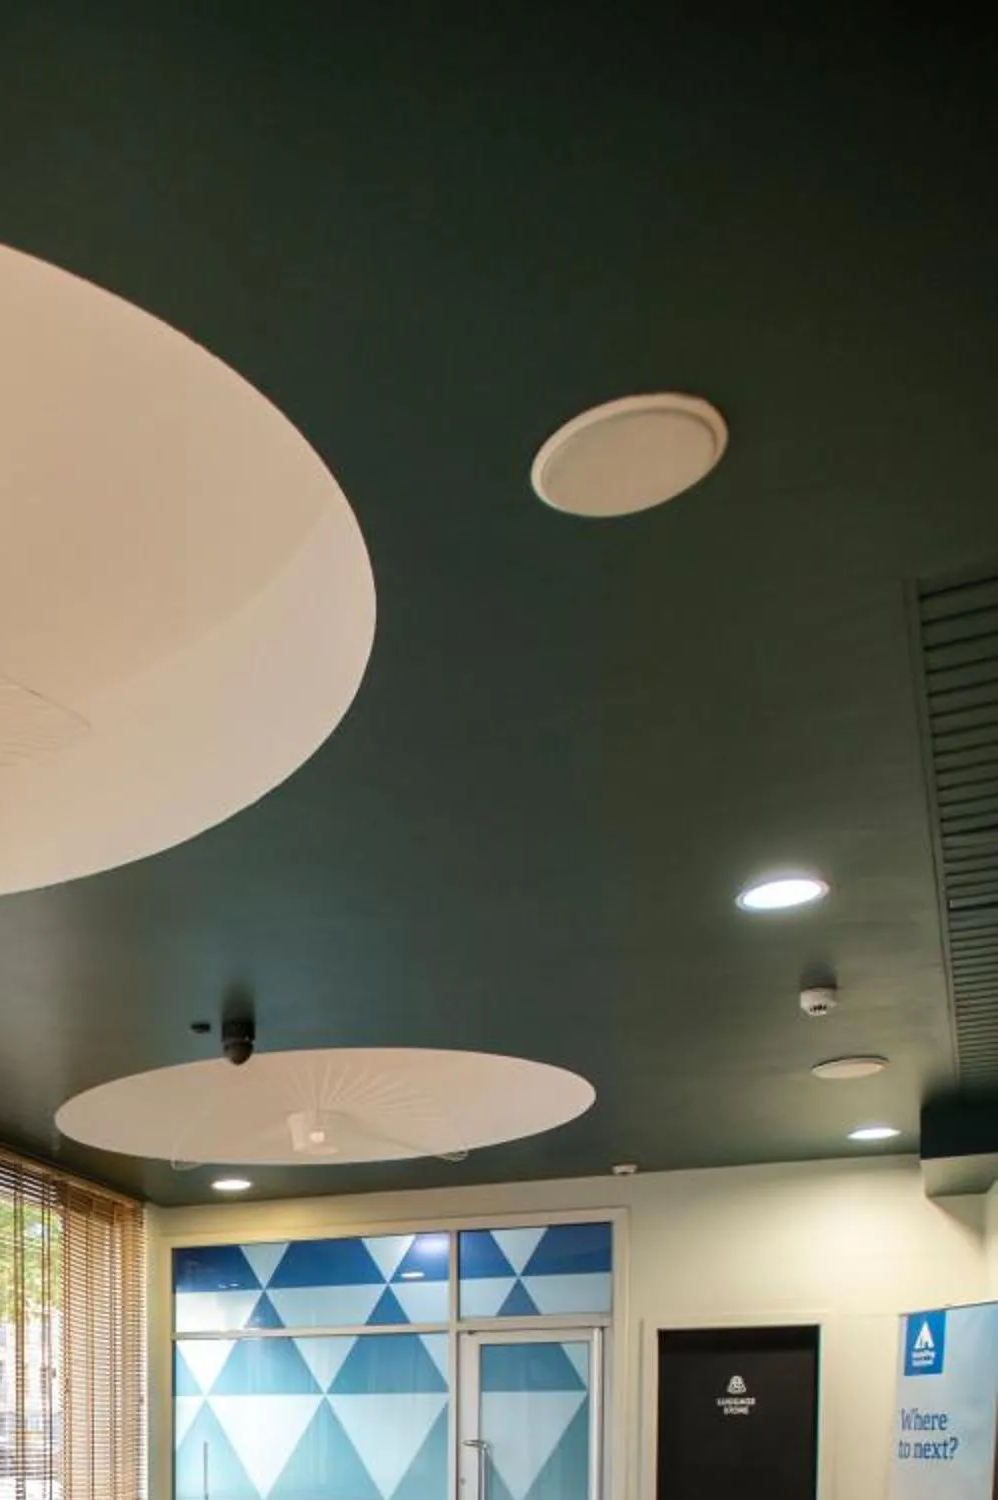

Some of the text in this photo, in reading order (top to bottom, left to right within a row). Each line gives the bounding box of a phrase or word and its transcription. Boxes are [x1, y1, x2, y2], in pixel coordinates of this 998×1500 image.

[900, 1407, 948, 1431] Where
[898, 1436, 959, 1460] to next?
